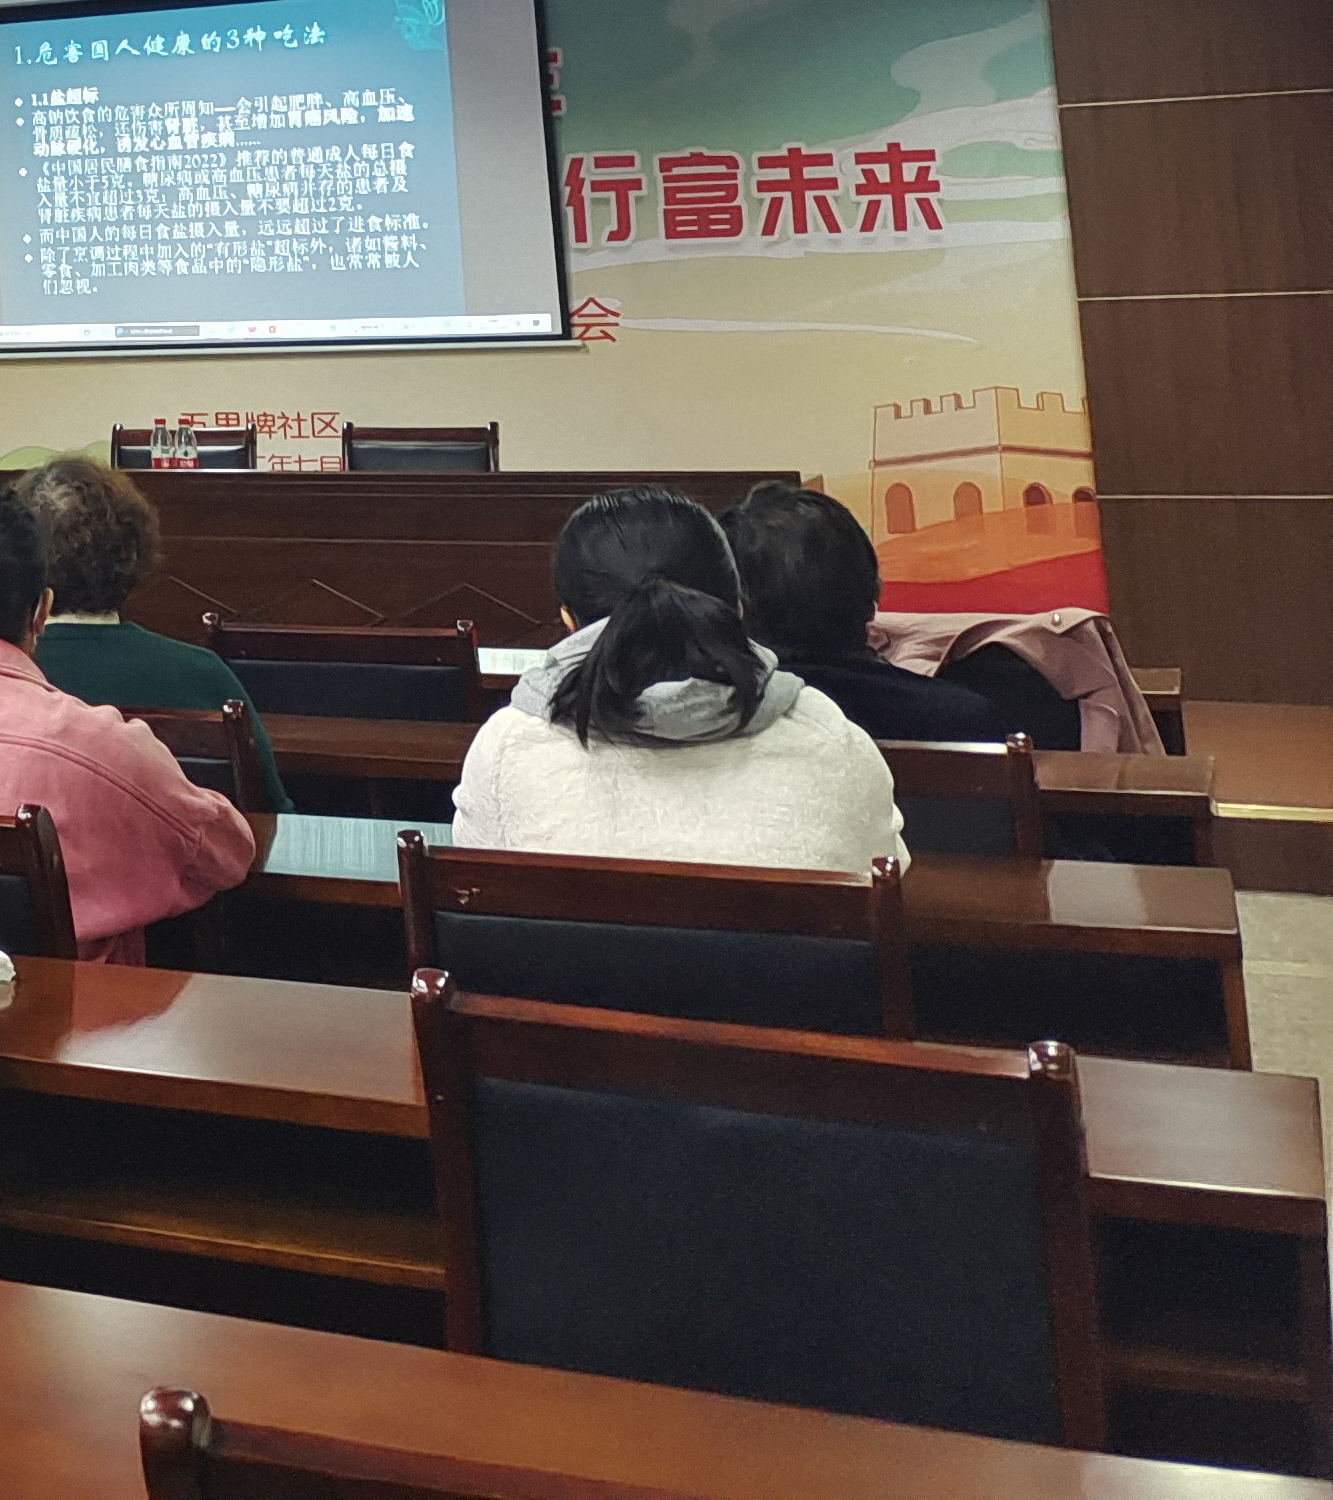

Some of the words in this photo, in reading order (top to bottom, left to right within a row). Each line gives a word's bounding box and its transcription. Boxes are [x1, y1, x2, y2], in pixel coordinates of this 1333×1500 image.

[14, 21, 326, 65] 1.危害国人健康的3种吃法
[31, 86, 100, 107] 1.1盐超标
[563, 142, 943, 244] 行富未来
[43, 278, 98, 295] 们忽视。
[570, 297, 622, 343] 会
